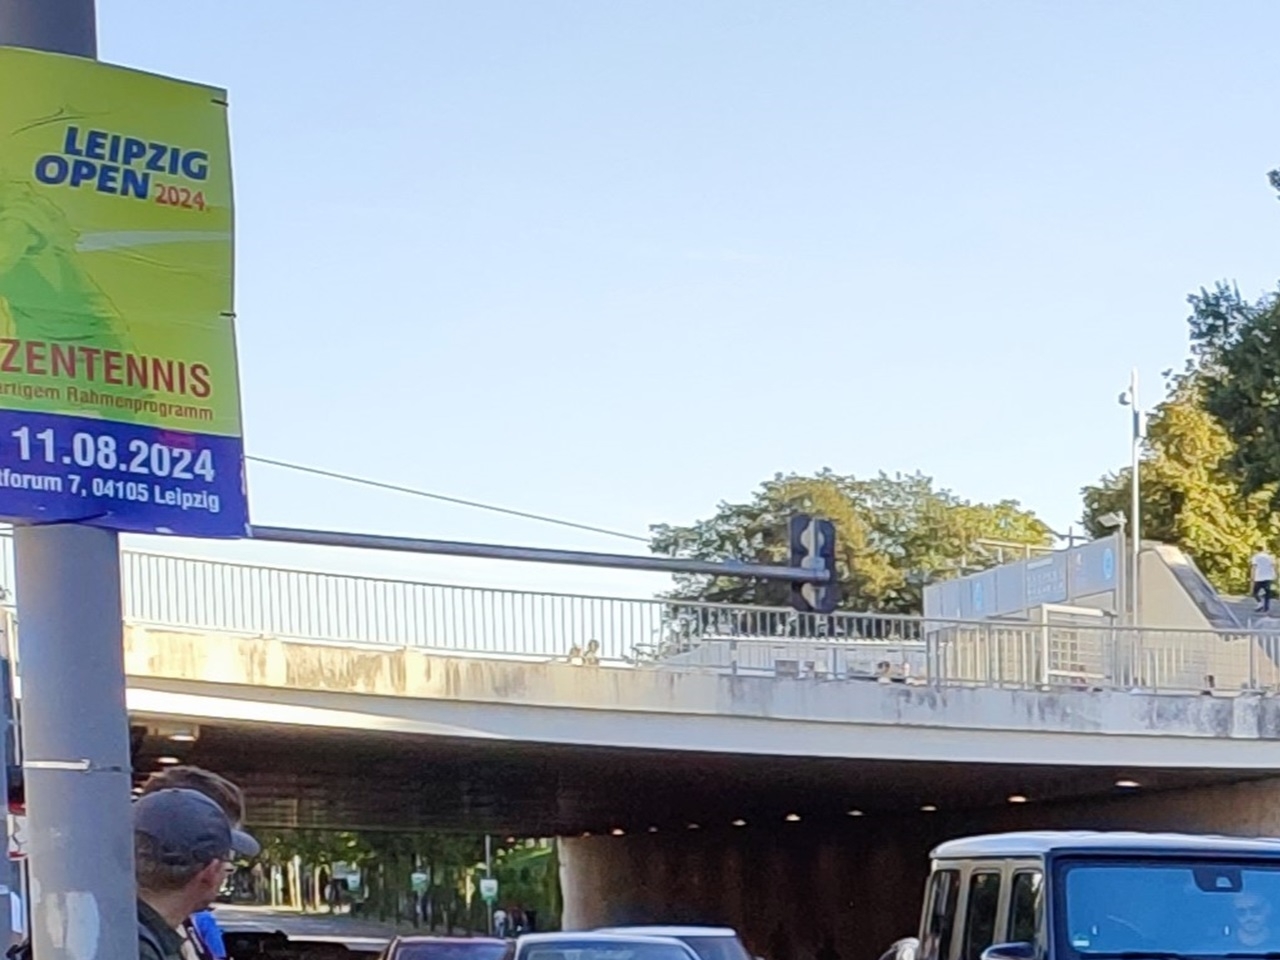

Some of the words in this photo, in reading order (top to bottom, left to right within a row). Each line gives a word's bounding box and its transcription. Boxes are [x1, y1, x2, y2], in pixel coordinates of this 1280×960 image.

[63, 125, 209, 181] LEIPZIG
[34, 154, 151, 200] OPEN
[67, 386, 214, 421] Rahmenprogramm
[11, 425, 216, 482] 11.08.2024
[67, 474, 87, 498] 7,
[92, 477, 149, 502] 04105
[154, 484, 220, 513] Leipzig
